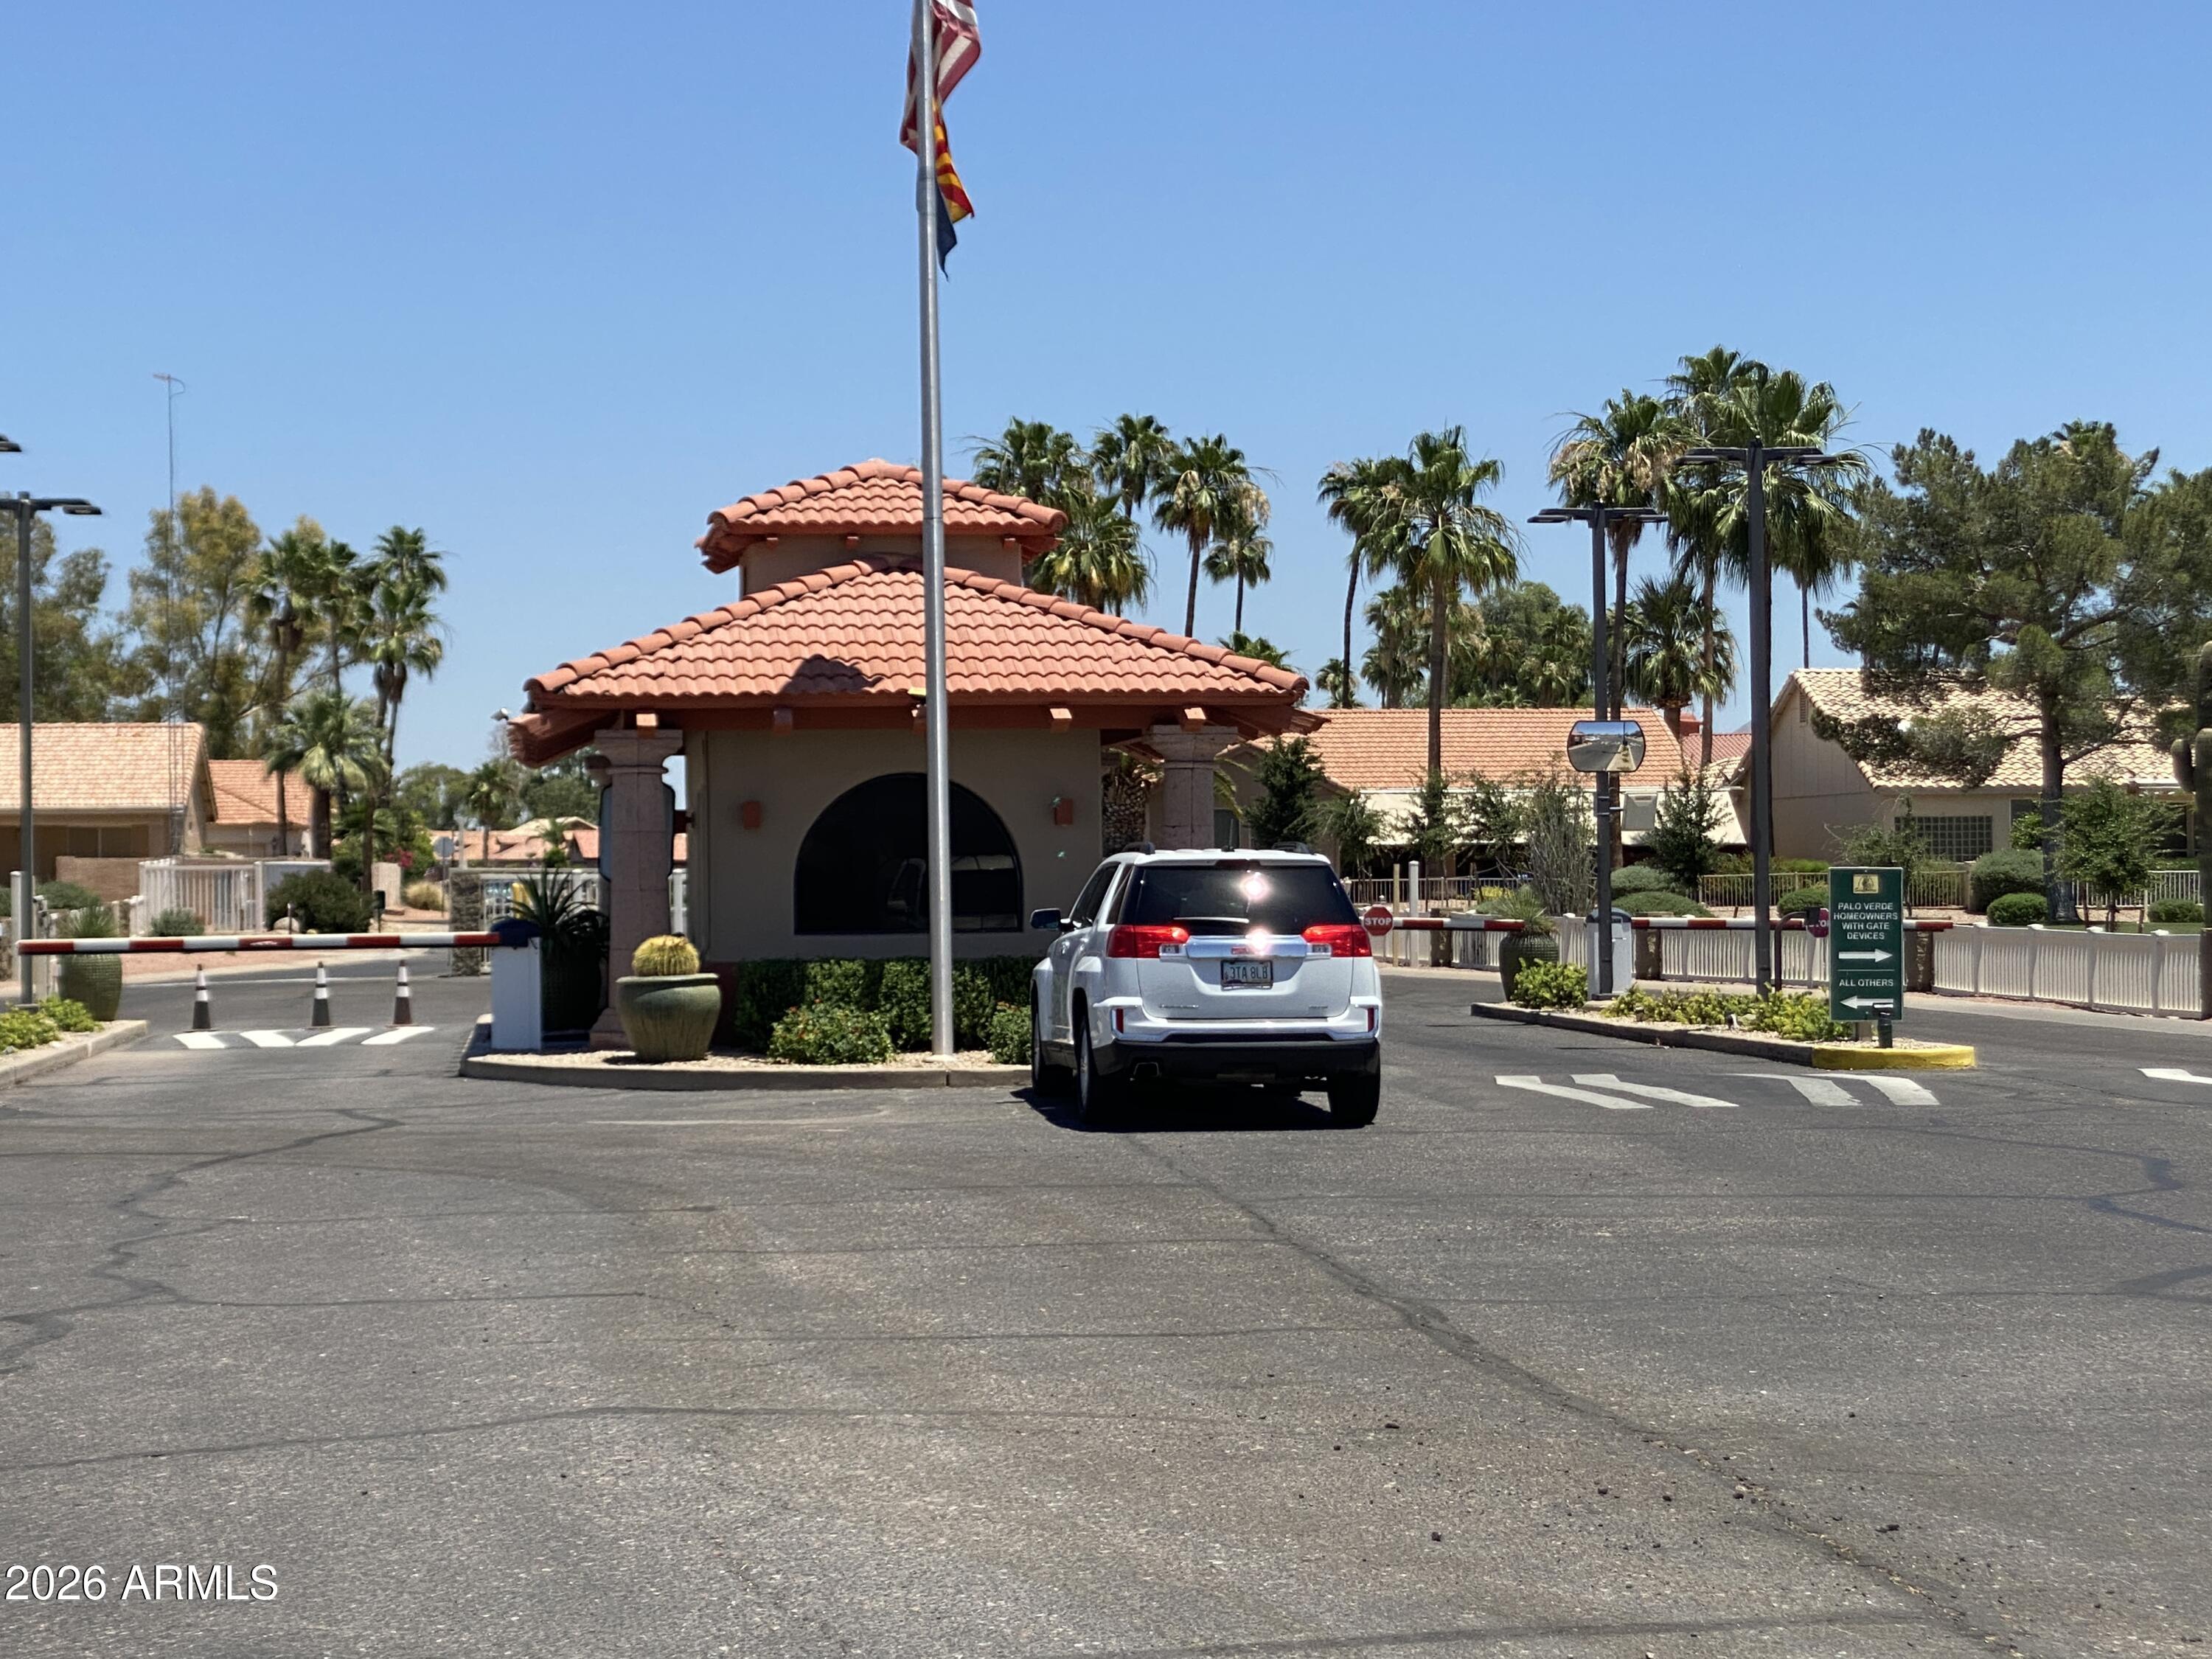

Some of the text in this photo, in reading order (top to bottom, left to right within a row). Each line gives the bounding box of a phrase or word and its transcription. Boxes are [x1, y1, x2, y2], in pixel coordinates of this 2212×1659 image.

[1837, 902, 1893, 911] PALO VERDE
[1833, 912, 1899, 920] HOMEOWNERS
[1365, 917, 1392, 925] STOP
[1842, 922, 1890, 931] WITH GATE
[1846, 932, 1885, 940] DEVICES
[1839, 978, 1894, 987] ALL OTHERS
